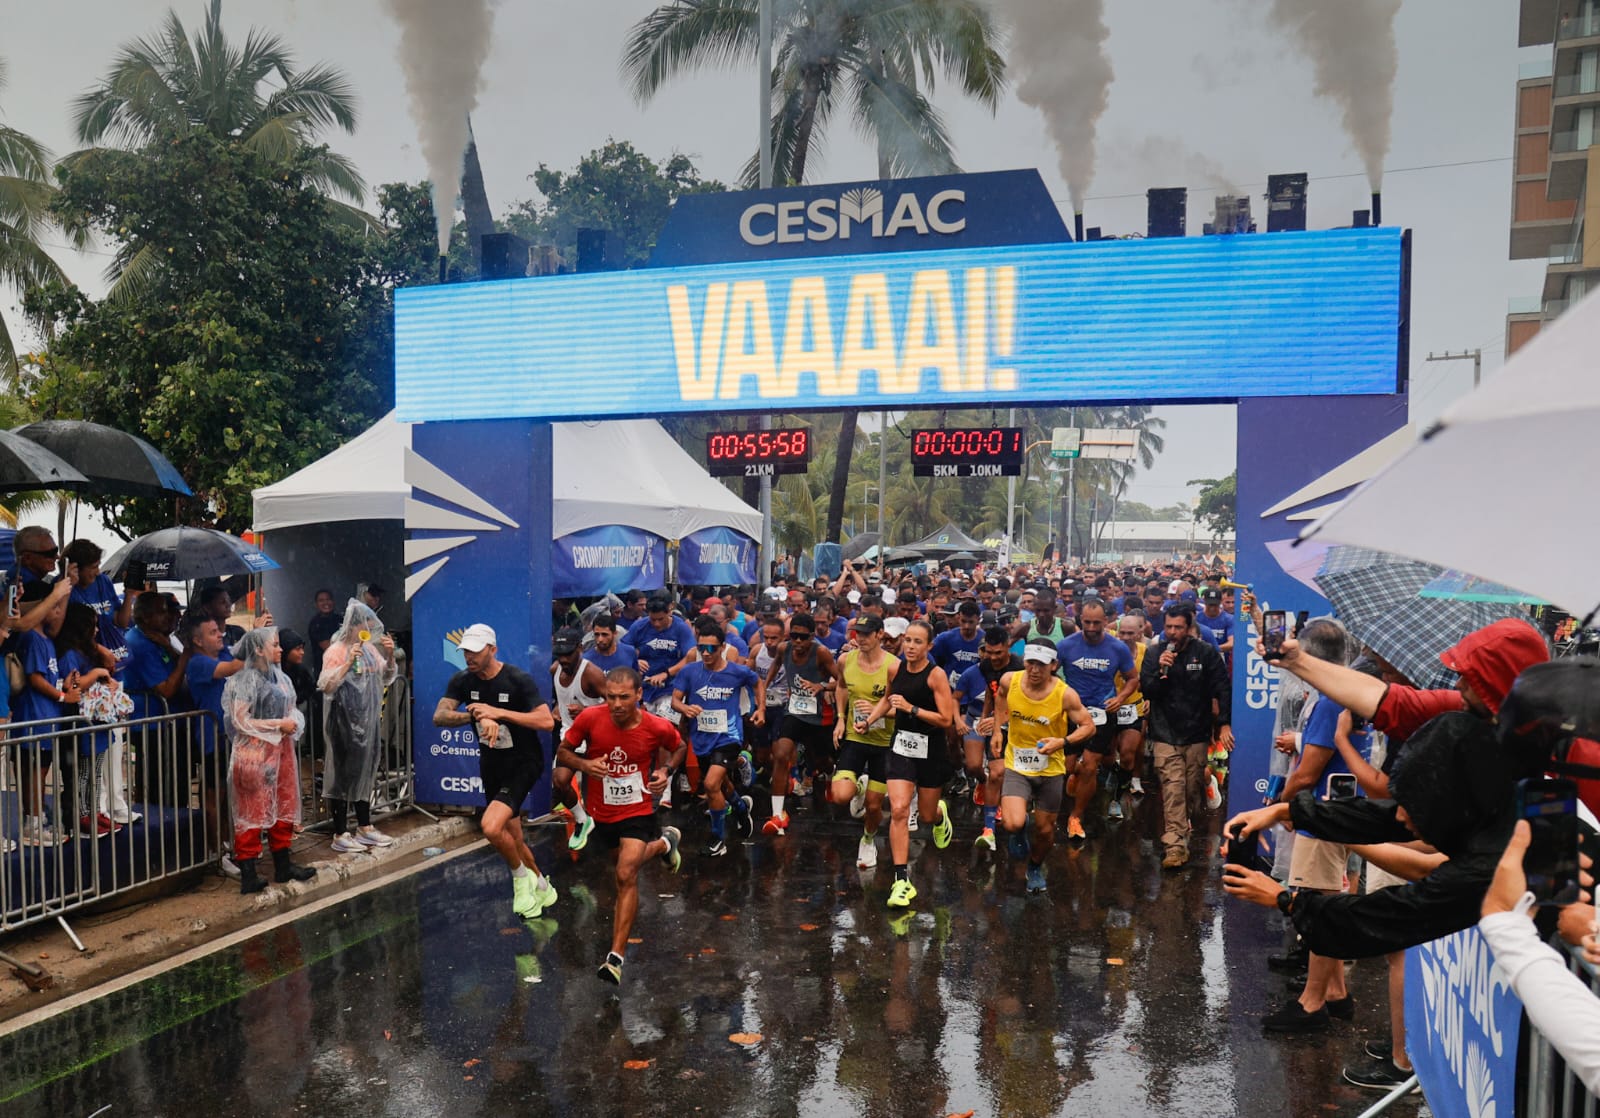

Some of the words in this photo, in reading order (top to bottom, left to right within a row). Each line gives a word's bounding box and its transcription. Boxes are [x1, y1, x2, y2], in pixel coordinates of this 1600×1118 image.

[739, 188, 966, 246] CESMAC
[667, 265, 1018, 401] VAAAAI!
[711, 431, 806, 459] 00:55:58
[914, 430, 1020, 456] 00:00:01
[745, 464, 775, 476] 21KM
[933, 464, 958, 476] 5KM
[970, 464, 1002, 476] 10KM
[701, 717, 718, 725] 1183
[900, 738, 918, 750] 1562
[1018, 756, 1040, 764] 1874
[441, 776, 485, 793] CESM
[609, 784, 633, 796] 1733
